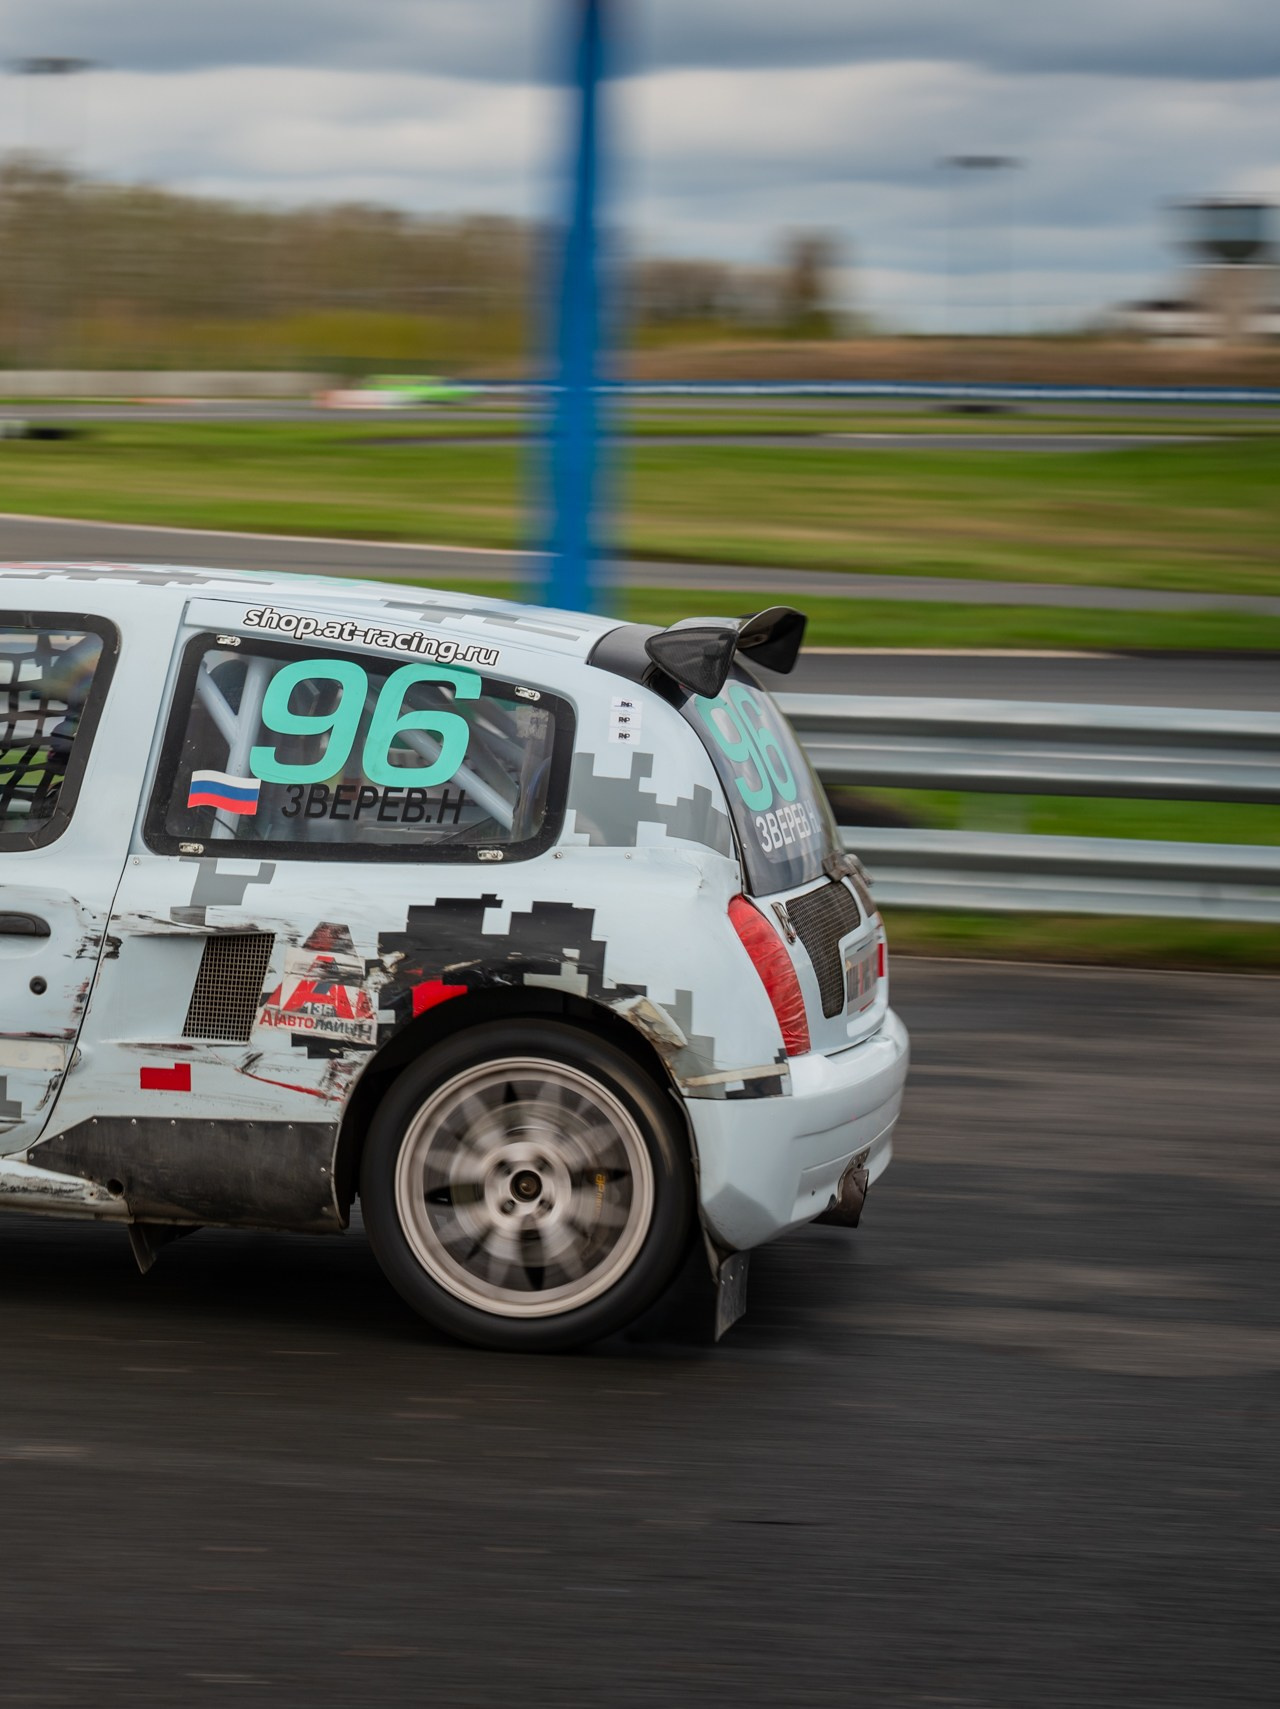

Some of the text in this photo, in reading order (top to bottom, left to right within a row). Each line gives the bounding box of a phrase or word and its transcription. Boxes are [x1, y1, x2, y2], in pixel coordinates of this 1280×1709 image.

[243, 608, 500, 666] shop.at-racing.ru
[249, 658, 482, 789] 96
[694, 685, 797, 811] 96
[281, 783, 466, 824] ЗВЕРЕВ.Н
